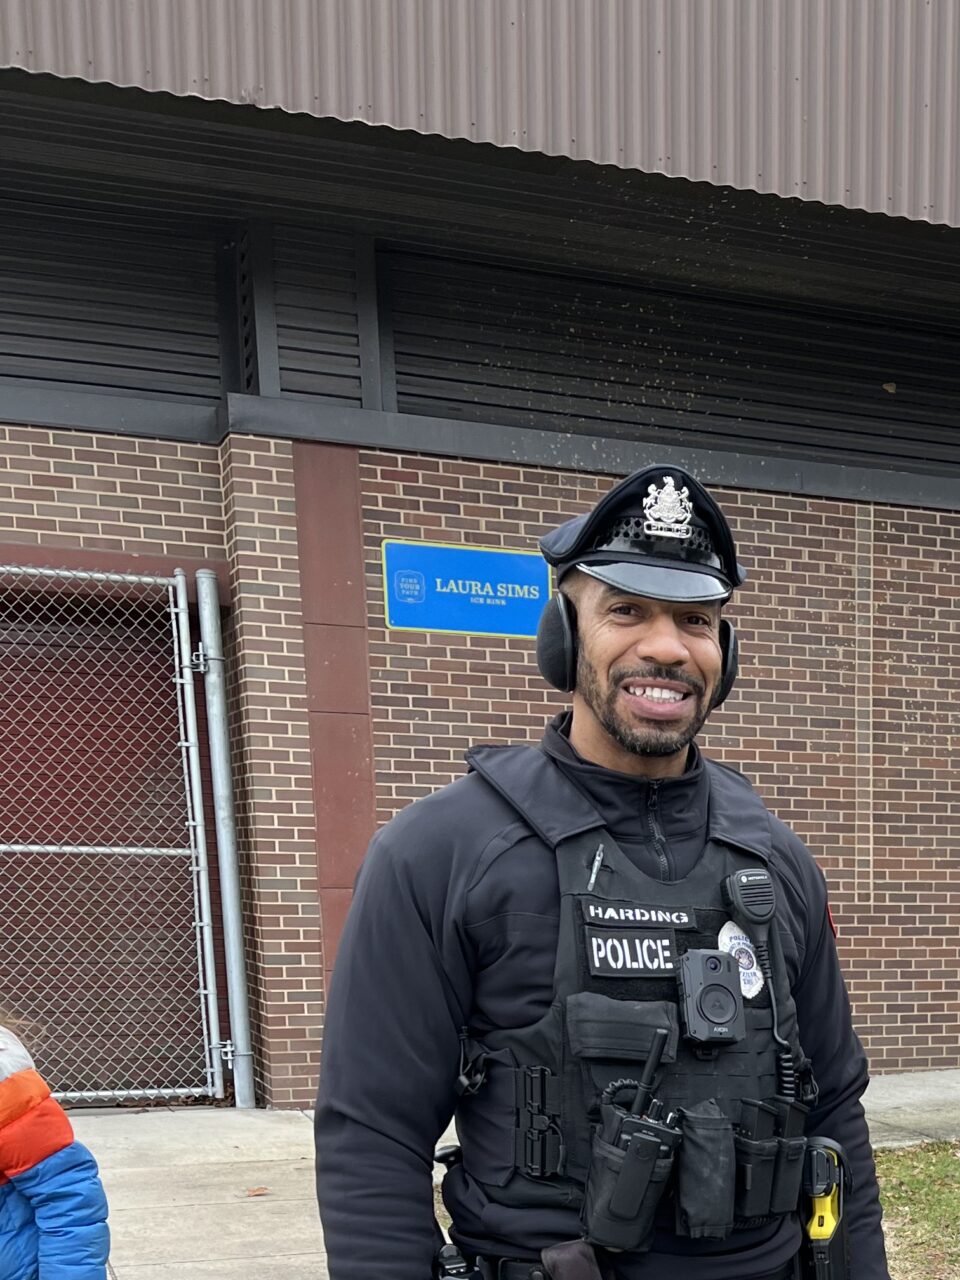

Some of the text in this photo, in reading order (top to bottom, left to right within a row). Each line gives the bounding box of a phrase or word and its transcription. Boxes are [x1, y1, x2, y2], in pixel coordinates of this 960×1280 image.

[435, 578, 540, 599] LAURA SIMS
[589, 905, 689, 923] HARDING
[591, 937, 674, 970] POLICE
